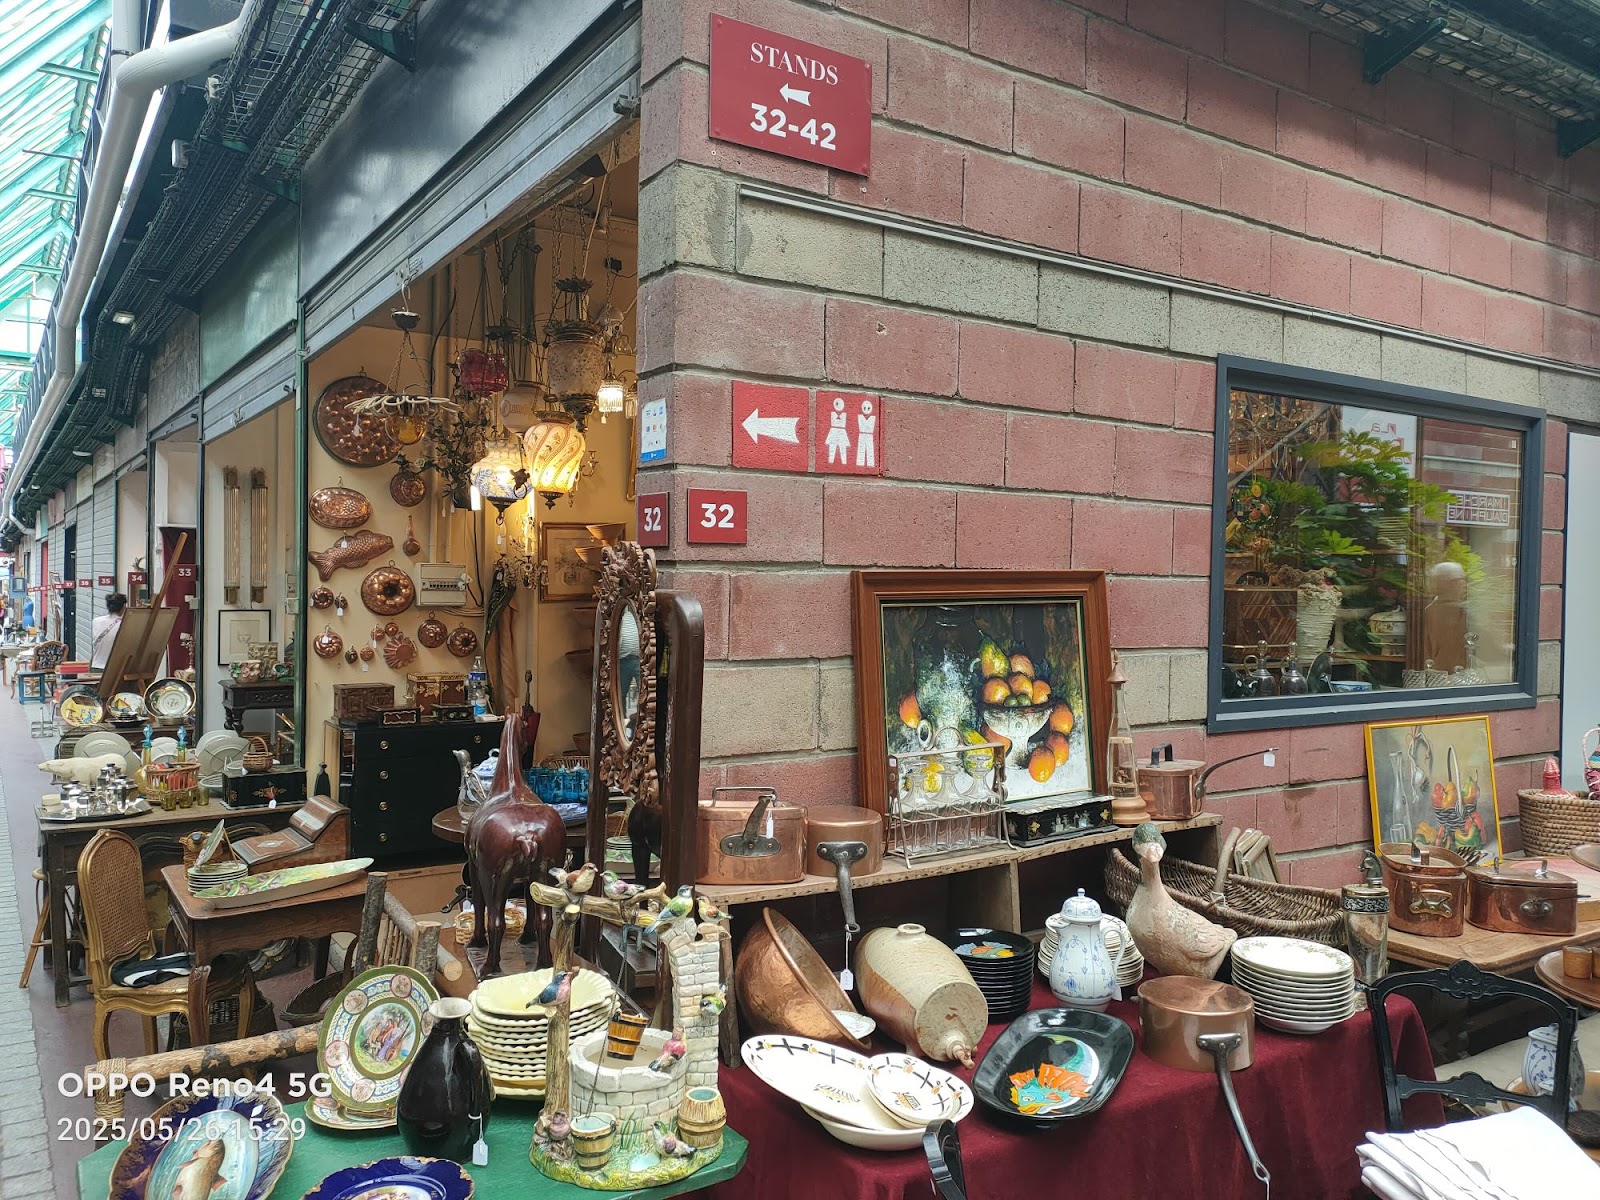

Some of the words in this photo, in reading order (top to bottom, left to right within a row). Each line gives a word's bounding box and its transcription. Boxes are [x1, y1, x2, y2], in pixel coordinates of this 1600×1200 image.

[750, 42, 839, 86] STANDS
[749, 103, 837, 151] 32-42
[643, 506, 662, 532] 32
[700, 503, 735, 529] 32
[131, 574, 143, 582] 34
[178, 568, 192, 577] 33
